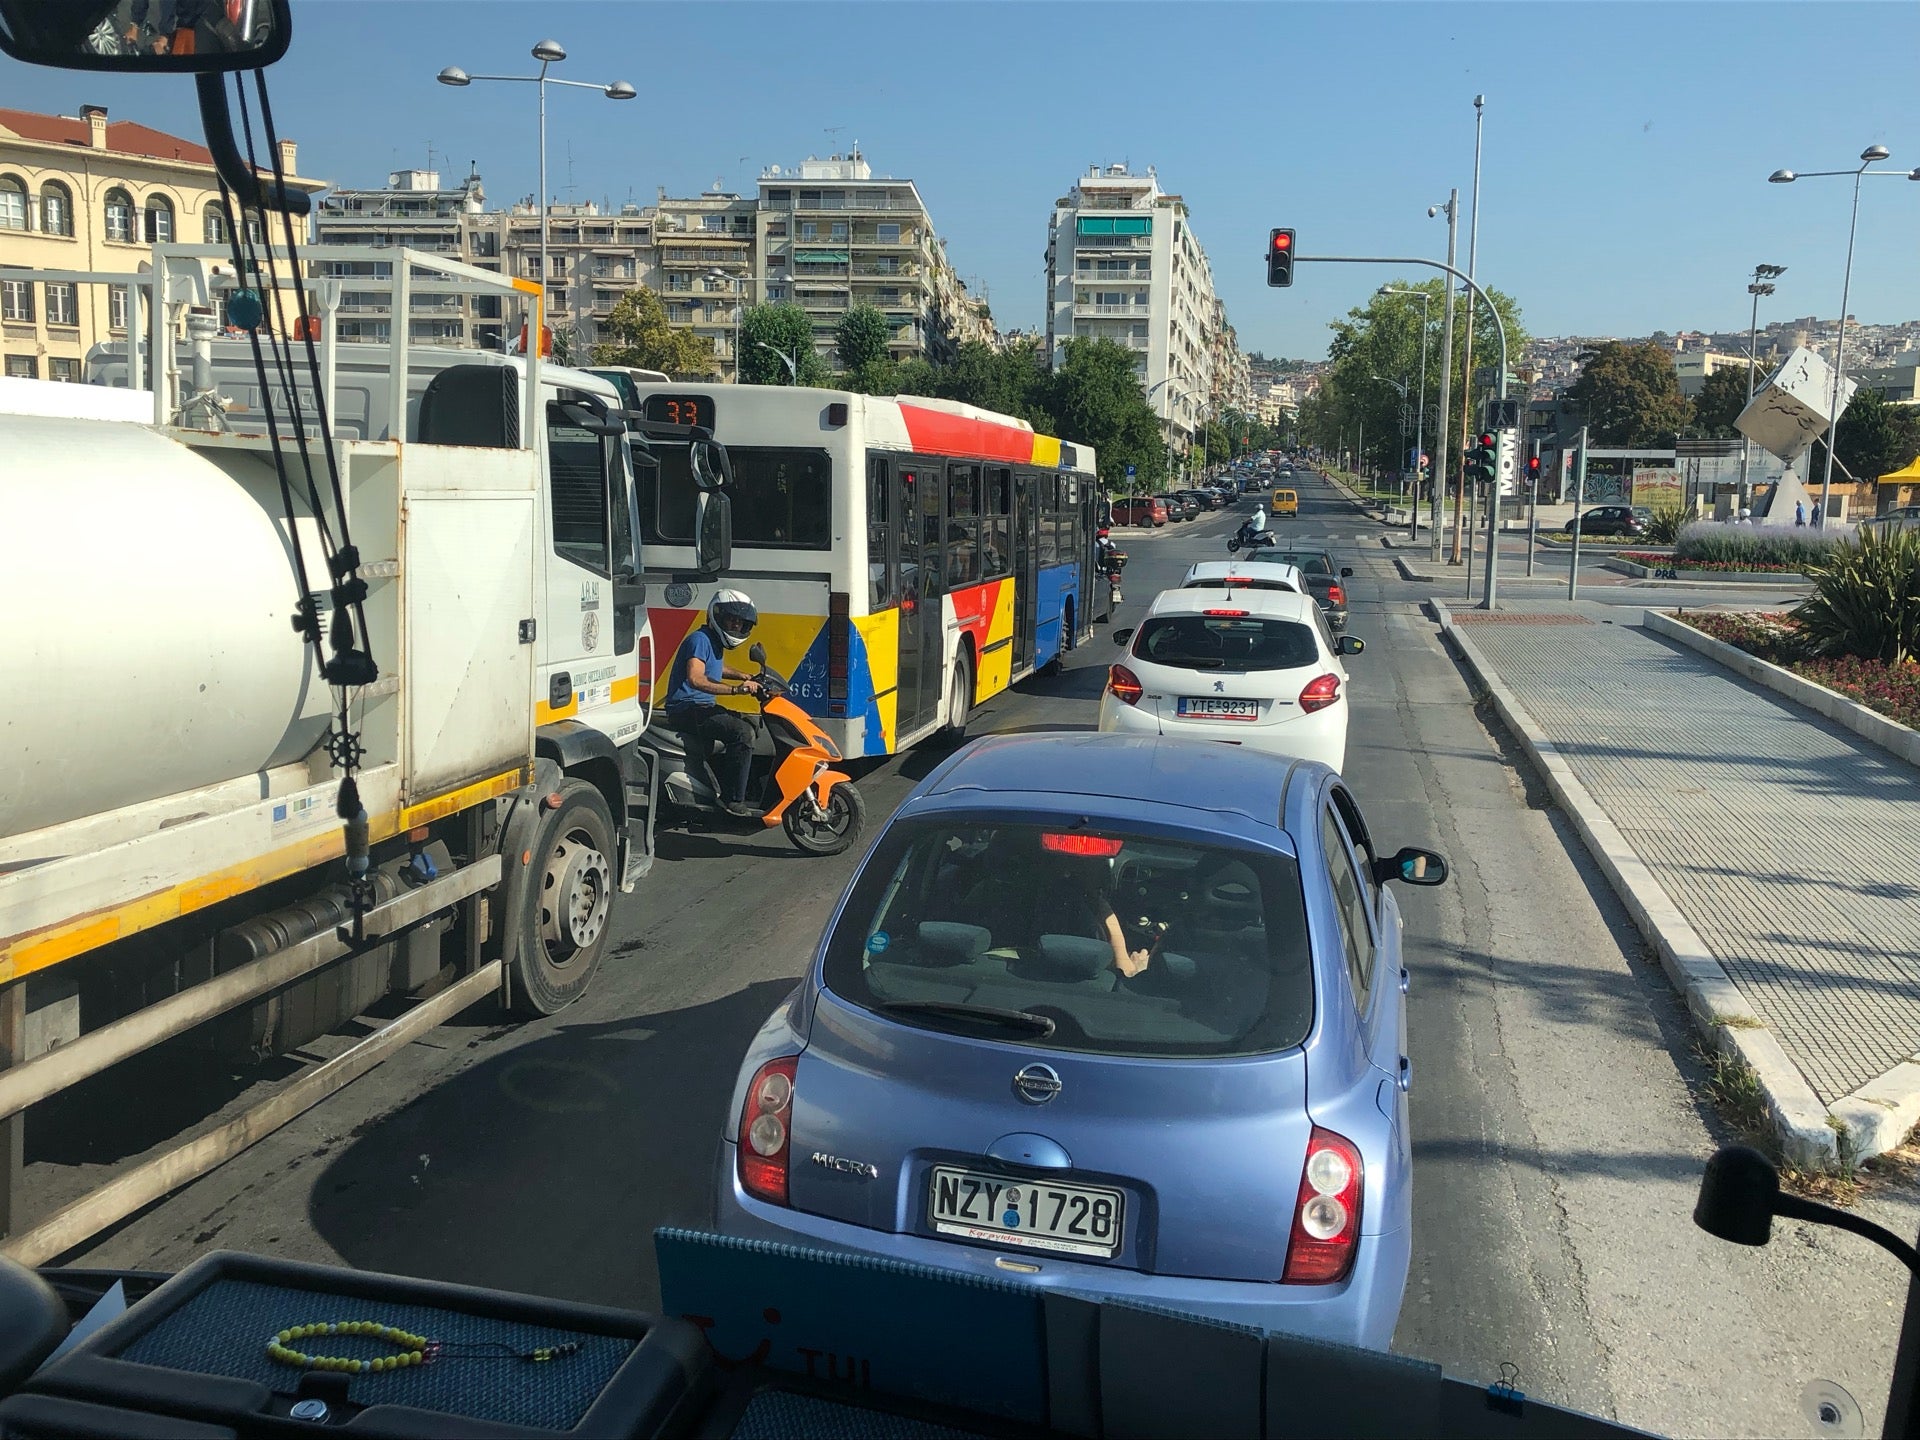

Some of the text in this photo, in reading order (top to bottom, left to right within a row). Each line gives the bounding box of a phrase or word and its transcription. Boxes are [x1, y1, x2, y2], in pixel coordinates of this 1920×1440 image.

[667, 400, 697, 426] 33
[1635, 471, 1658, 482] BEER
[811, 1152, 878, 1179] MICRA
[796, 1347, 871, 1390] TUI
